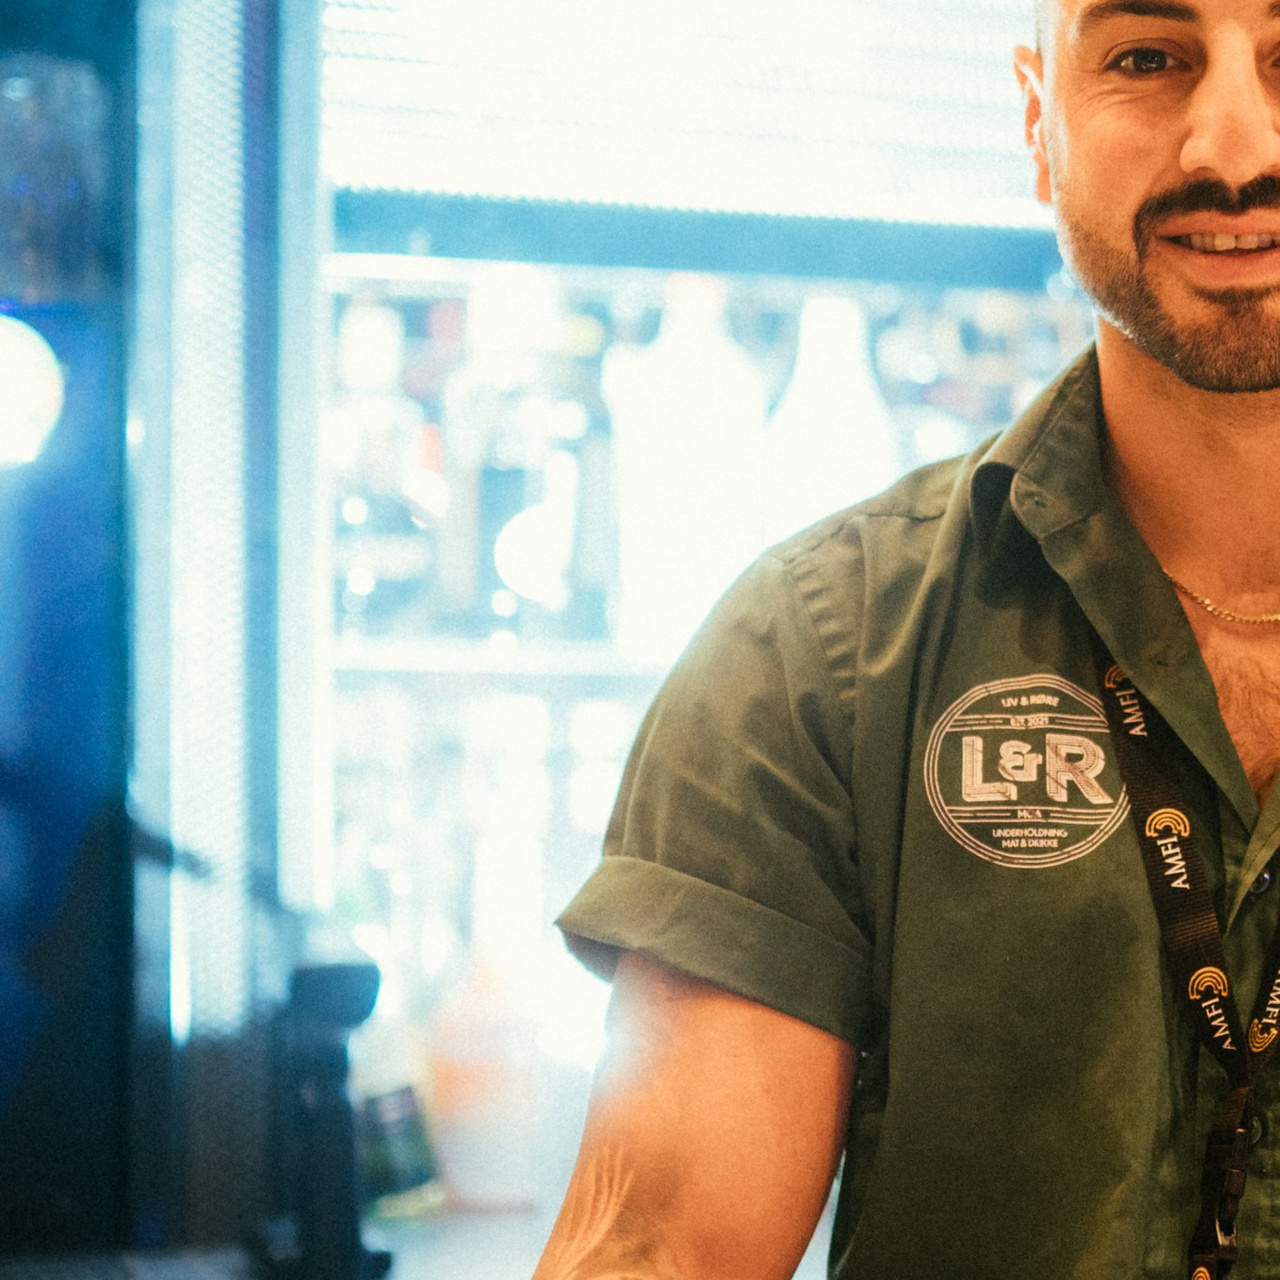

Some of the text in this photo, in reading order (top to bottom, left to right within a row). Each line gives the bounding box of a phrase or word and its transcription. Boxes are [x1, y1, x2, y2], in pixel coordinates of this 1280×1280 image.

[1116, 689, 1148, 737] AMFI
[962, 733, 1114, 804] L&R
[992, 828, 1068, 838] UNDERHOLDNING
[1157, 835, 1191, 890] AMFI
[1200, 998, 1237, 1052] AMFI
